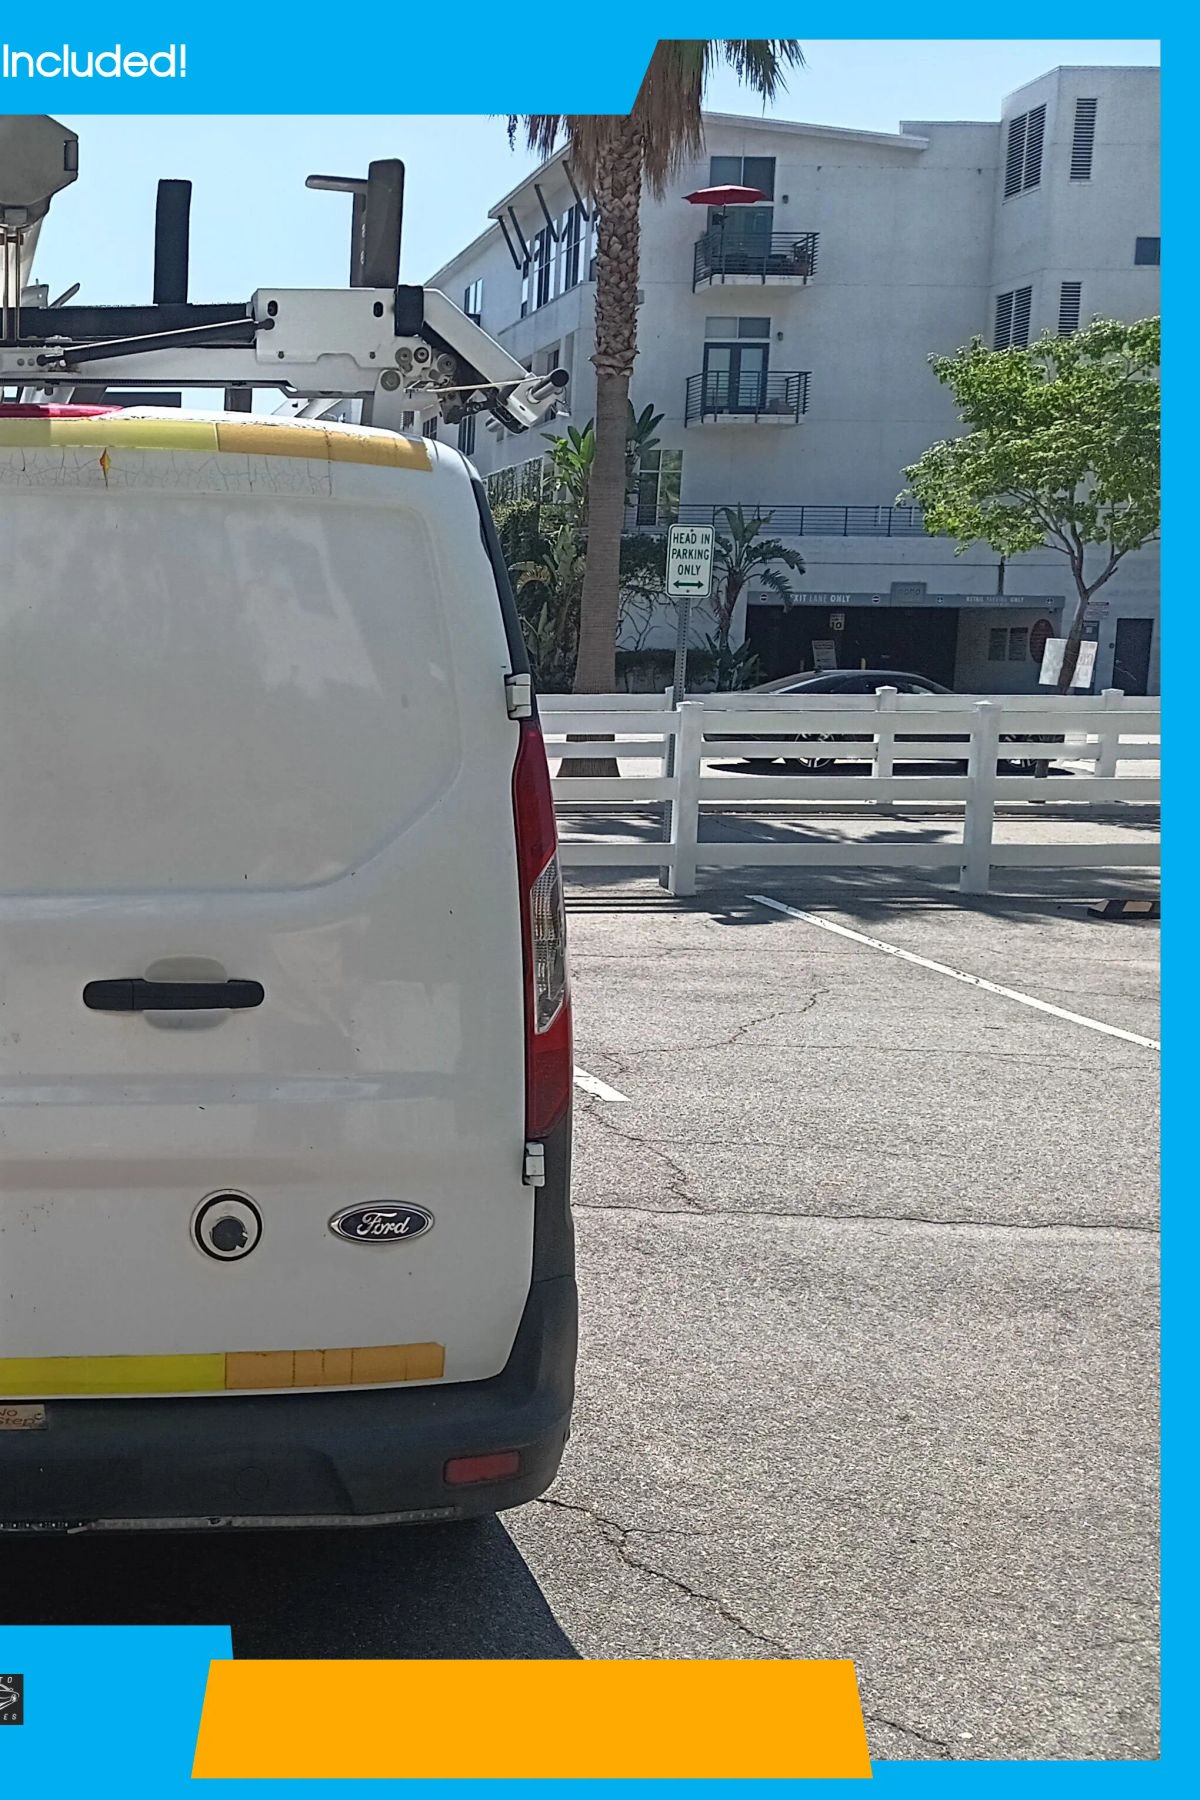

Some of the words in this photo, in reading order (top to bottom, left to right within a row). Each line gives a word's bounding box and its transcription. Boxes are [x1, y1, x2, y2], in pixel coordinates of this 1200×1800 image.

[673, 532, 697, 544] HEAD
[702, 533, 710, 545] IN
[671, 548, 710, 560] PARKING
[677, 564, 701, 576] ONLY
[830, 594, 851, 603] ONLY
[356, 1212, 411, 1237] Ford
